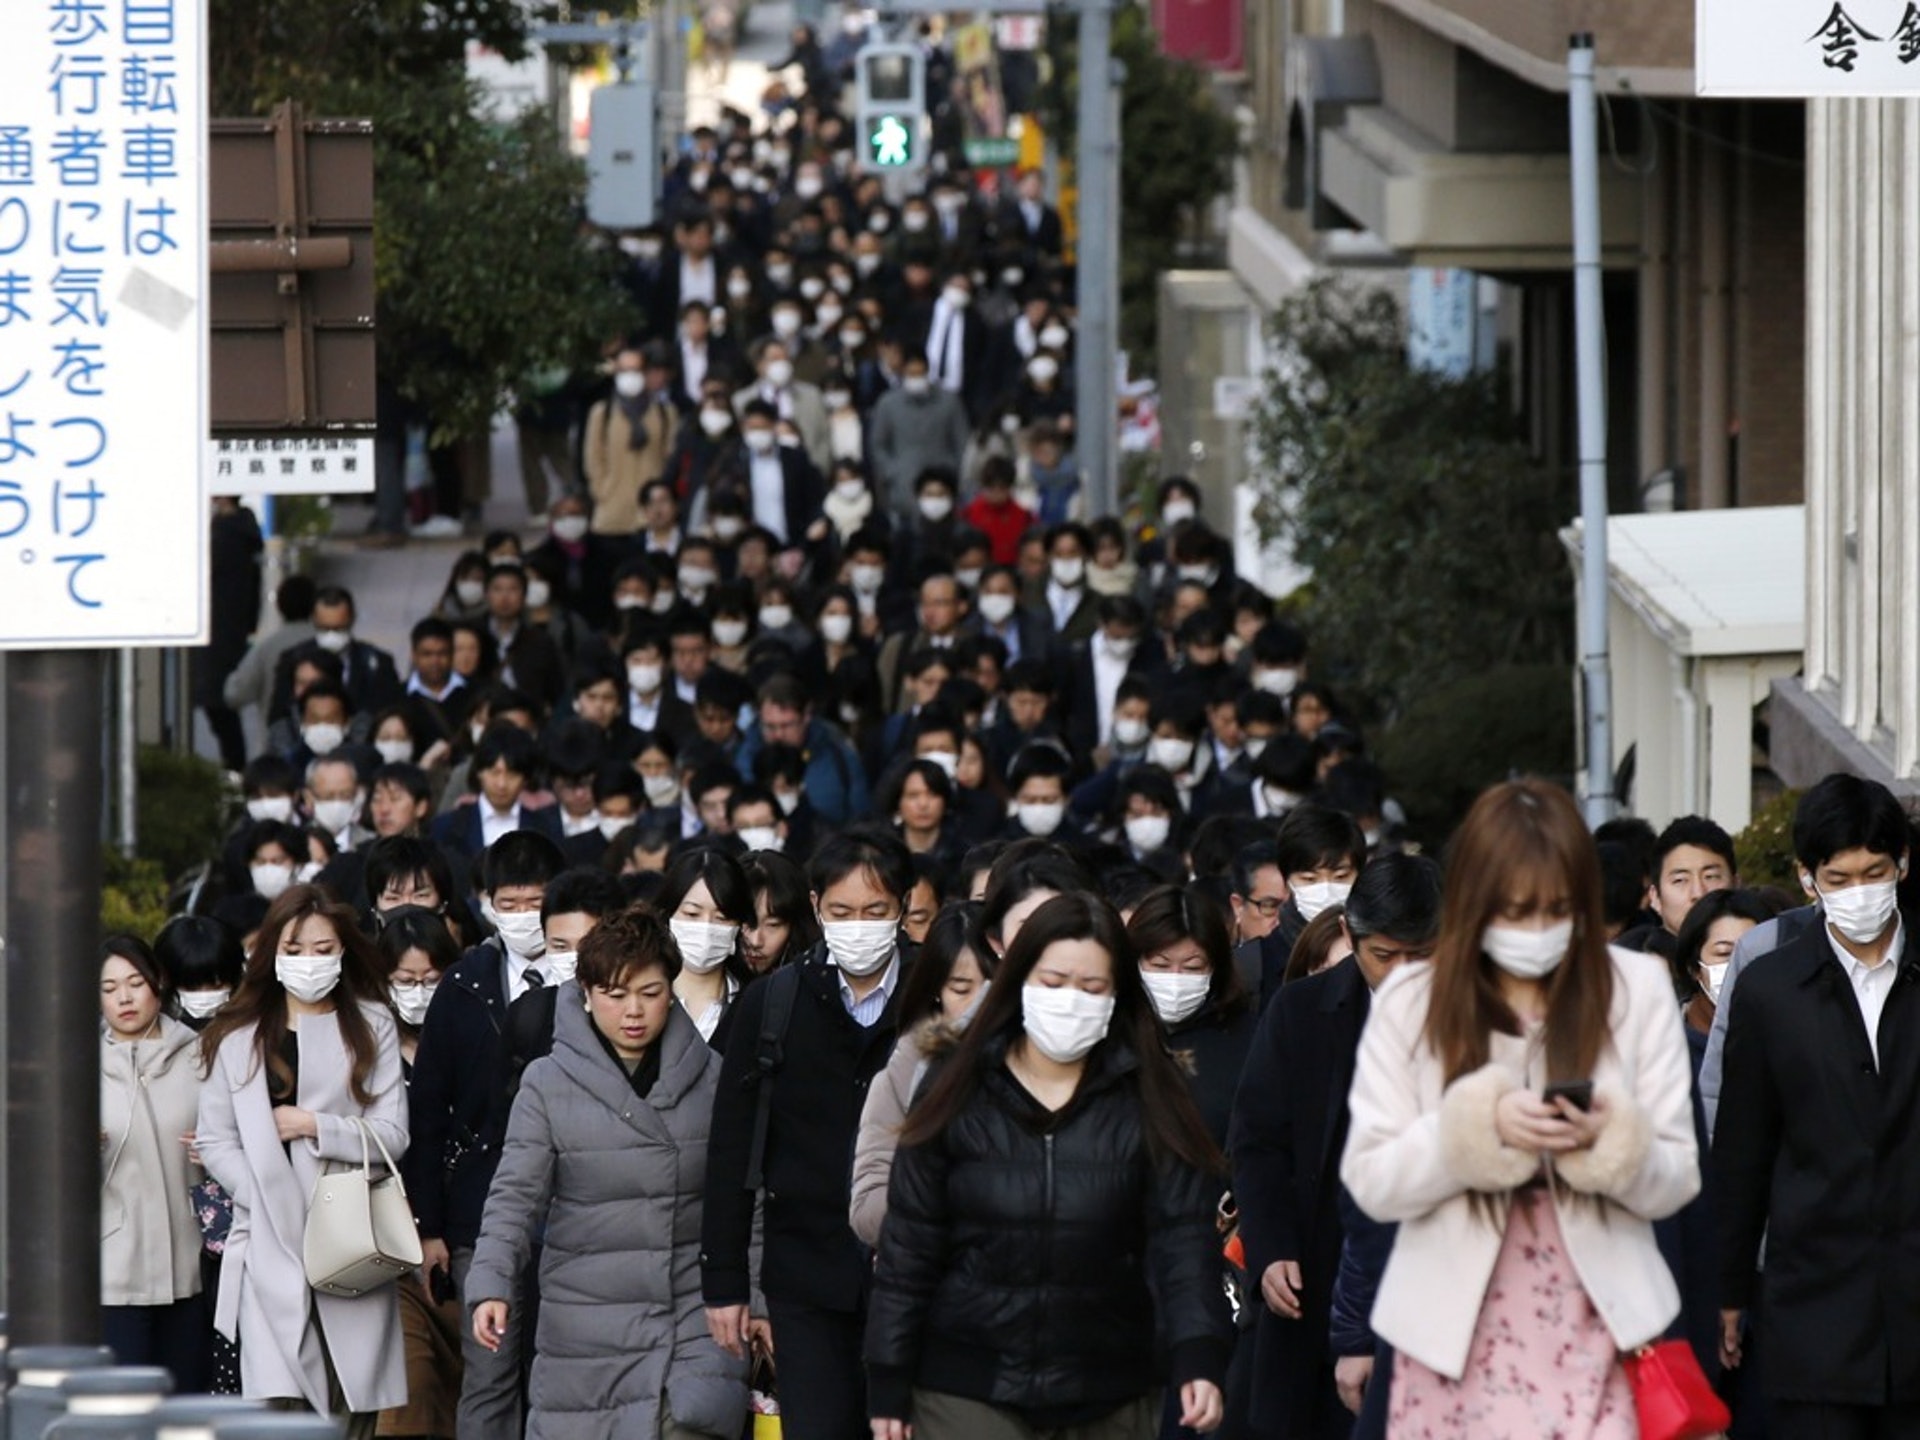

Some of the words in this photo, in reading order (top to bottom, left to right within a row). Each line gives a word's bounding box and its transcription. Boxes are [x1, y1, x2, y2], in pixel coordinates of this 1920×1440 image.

[49, 0, 108, 608] 歩行者に気をつけて
[119, 0, 178, 255] 自転車は
